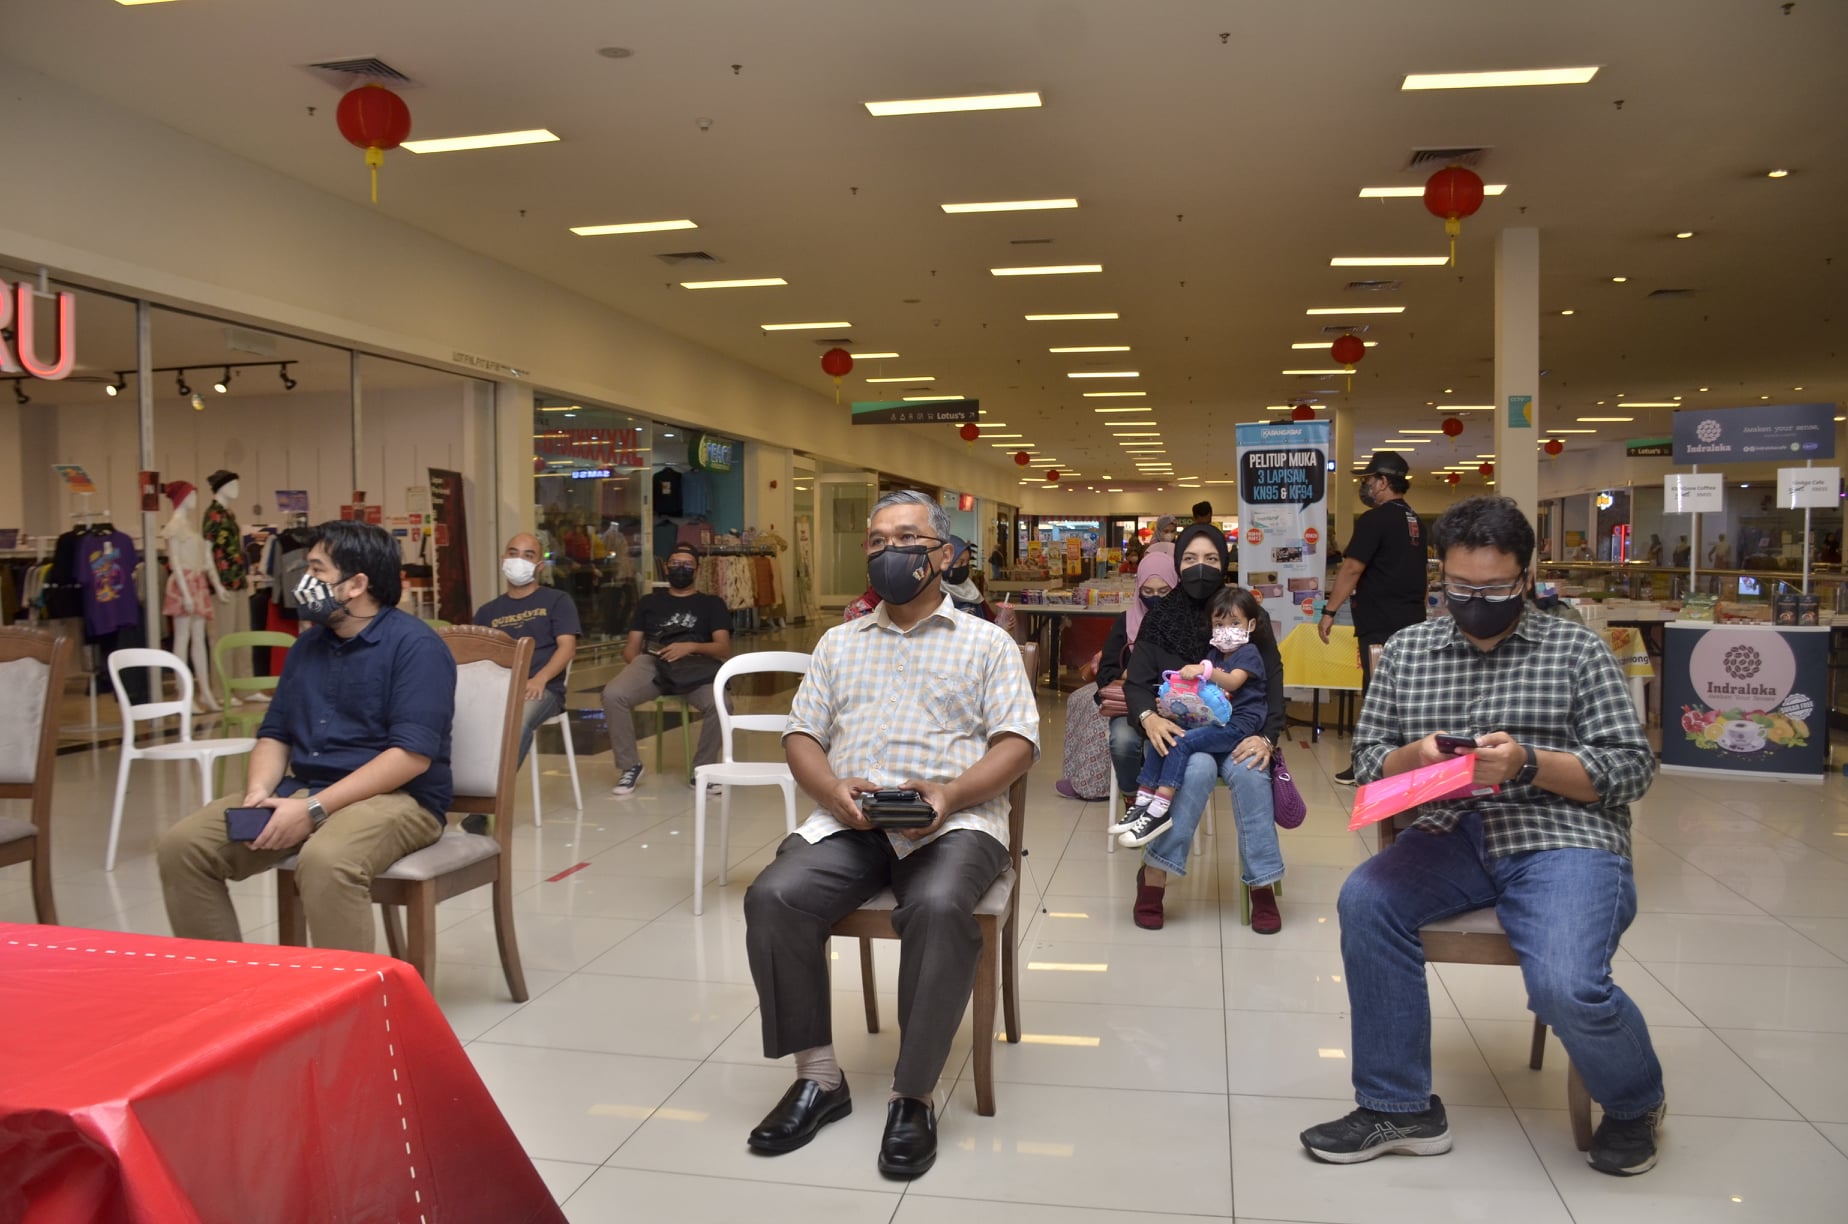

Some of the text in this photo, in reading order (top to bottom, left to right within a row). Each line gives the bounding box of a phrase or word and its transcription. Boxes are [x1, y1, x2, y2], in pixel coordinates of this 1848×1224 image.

[937, 412, 965, 420] Lotus's
[1687, 443, 1732, 454] Indraloka
[1249, 453, 1287, 468] PELITUP
[1288, 452, 1317, 467] MUKA
[1257, 469, 1308, 484] 3 LAPISAN,
[1253, 484, 1313, 500] KN95 & KF94
[1707, 681, 1777, 696] Indraloka
